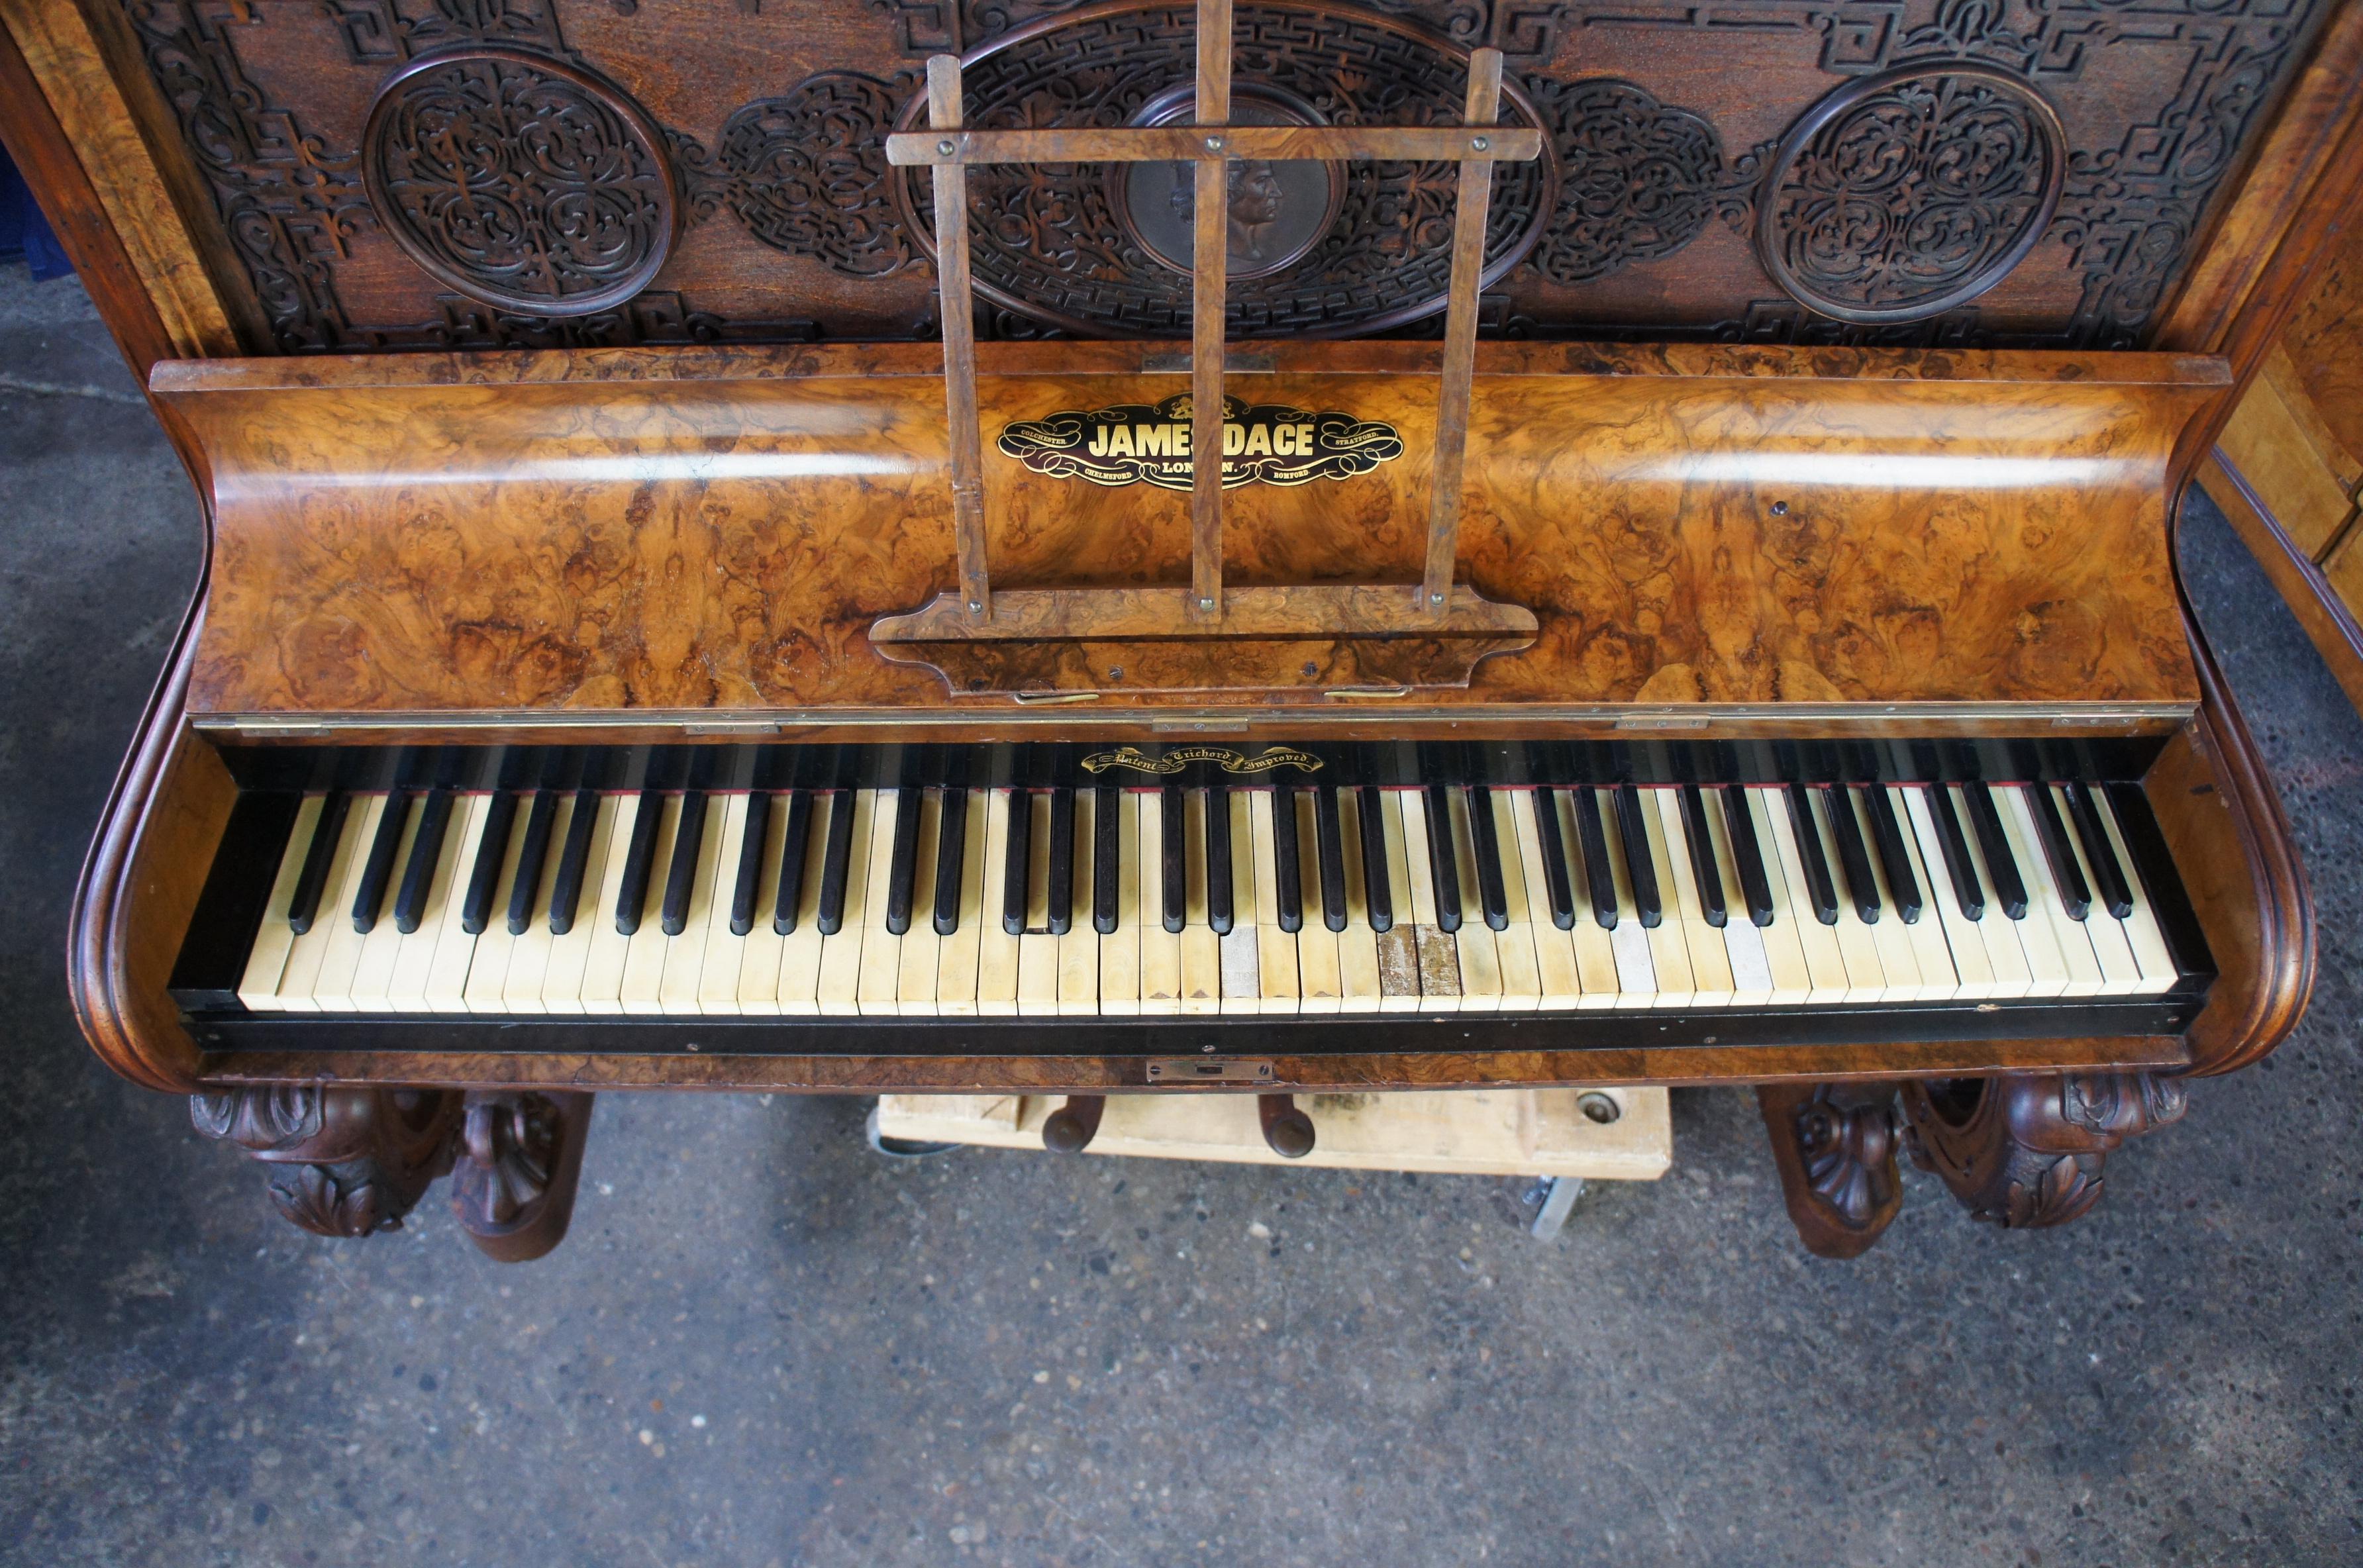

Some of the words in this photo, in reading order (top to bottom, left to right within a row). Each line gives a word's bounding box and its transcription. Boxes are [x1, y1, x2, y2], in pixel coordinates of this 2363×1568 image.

[1088, 424, 1193, 457] JAME
[1223, 424, 1314, 456] DACE
[1335, 432, 1379, 446] STRATFORD.
[1162, 462, 1238, 473] LONN.
